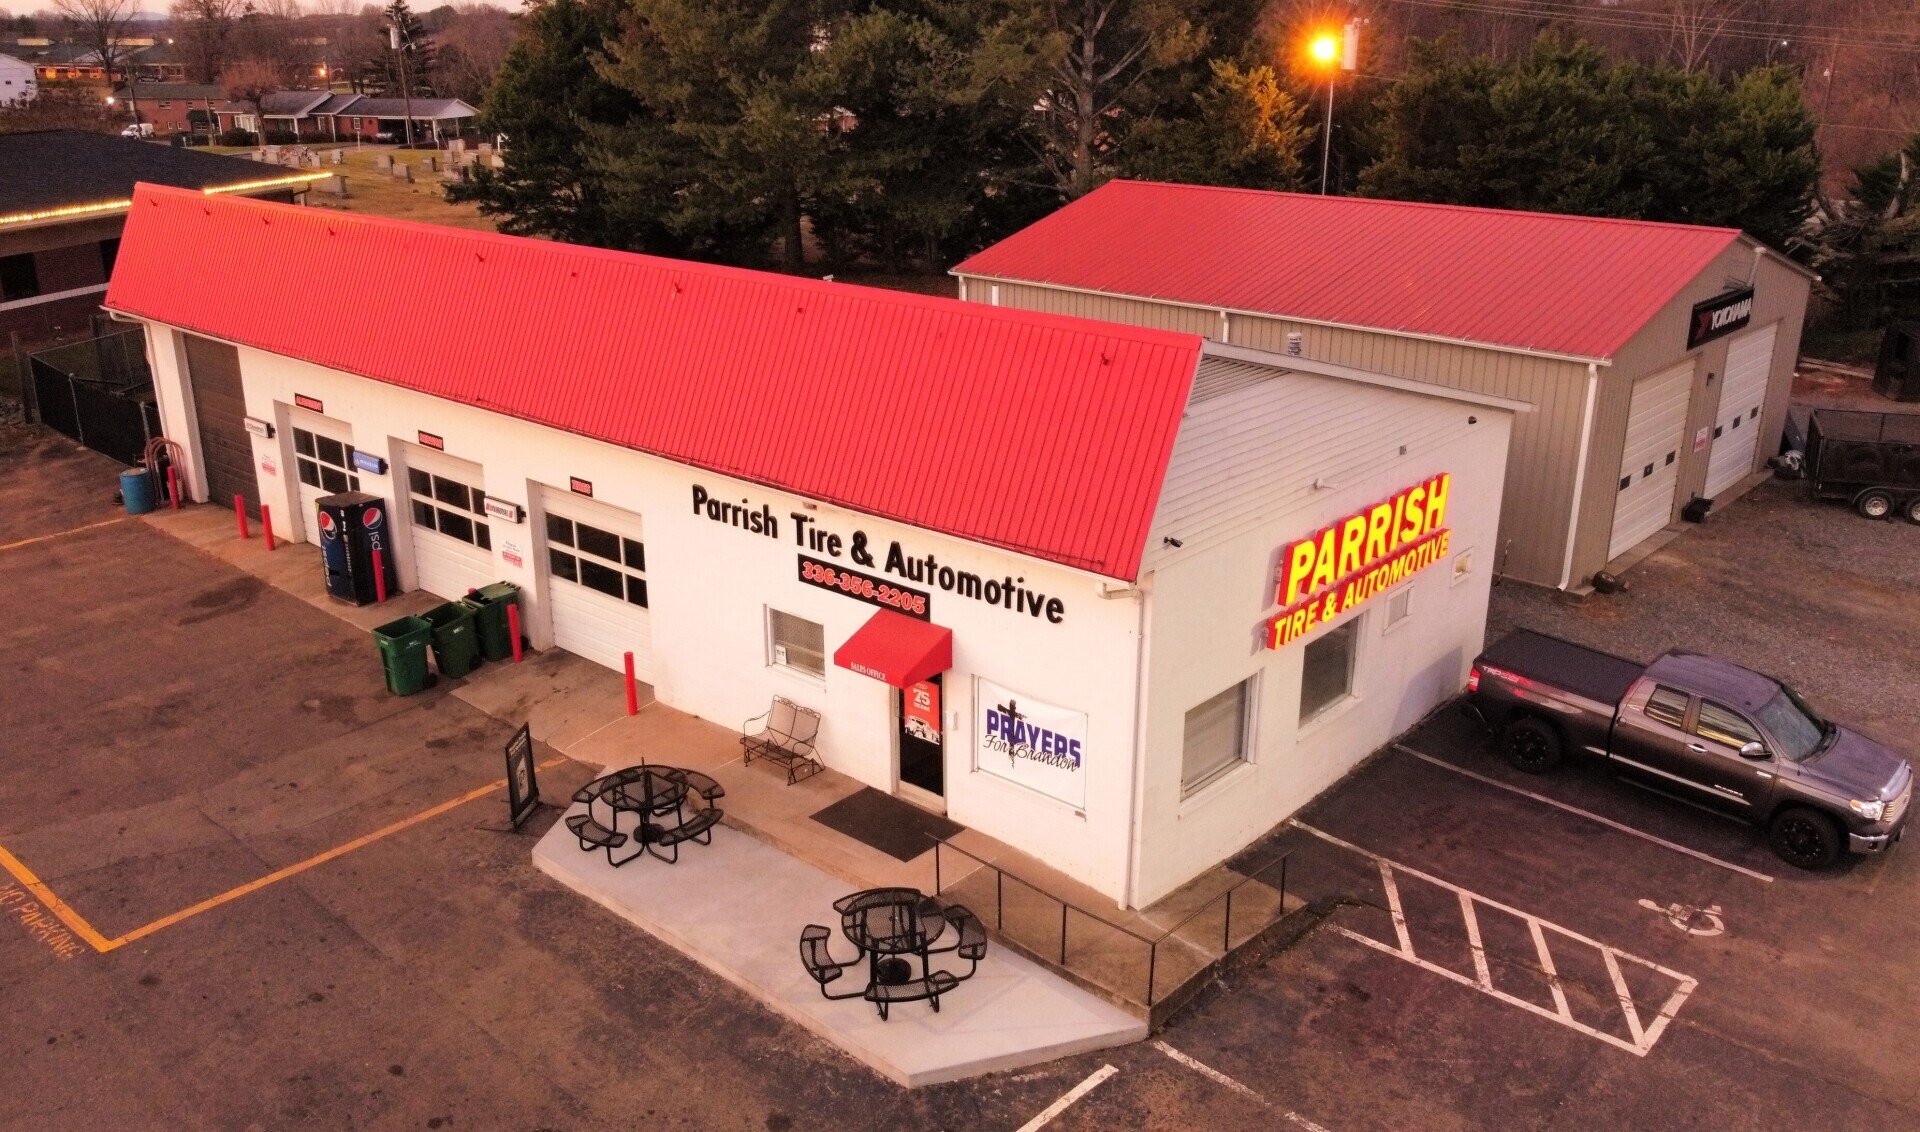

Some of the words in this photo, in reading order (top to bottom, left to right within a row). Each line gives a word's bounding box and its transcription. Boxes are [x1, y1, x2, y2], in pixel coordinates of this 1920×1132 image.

[1711, 298, 1752, 331] YOKOHAMA
[692, 484, 778, 539] Parrish
[791, 511, 842, 557] Tire
[851, 530, 875, 568] &
[885, 541, 1065, 624] Automotive
[1279, 473, 1451, 606] PARRISH
[802, 560, 925, 614] 336-356-2205
[1269, 600, 1319, 650] TIRE
[1320, 592, 1337, 623] &
[1340, 530, 1451, 614] AUTOMOTIVE
[851, 662, 866, 673] SALES
[866, 667, 886, 680] OFFICE
[913, 687, 931, 706] 75
[983, 734, 1008, 753] For
[1015, 742, 1078, 772] Brandon
[987, 709, 1081, 769] PRAYERS
